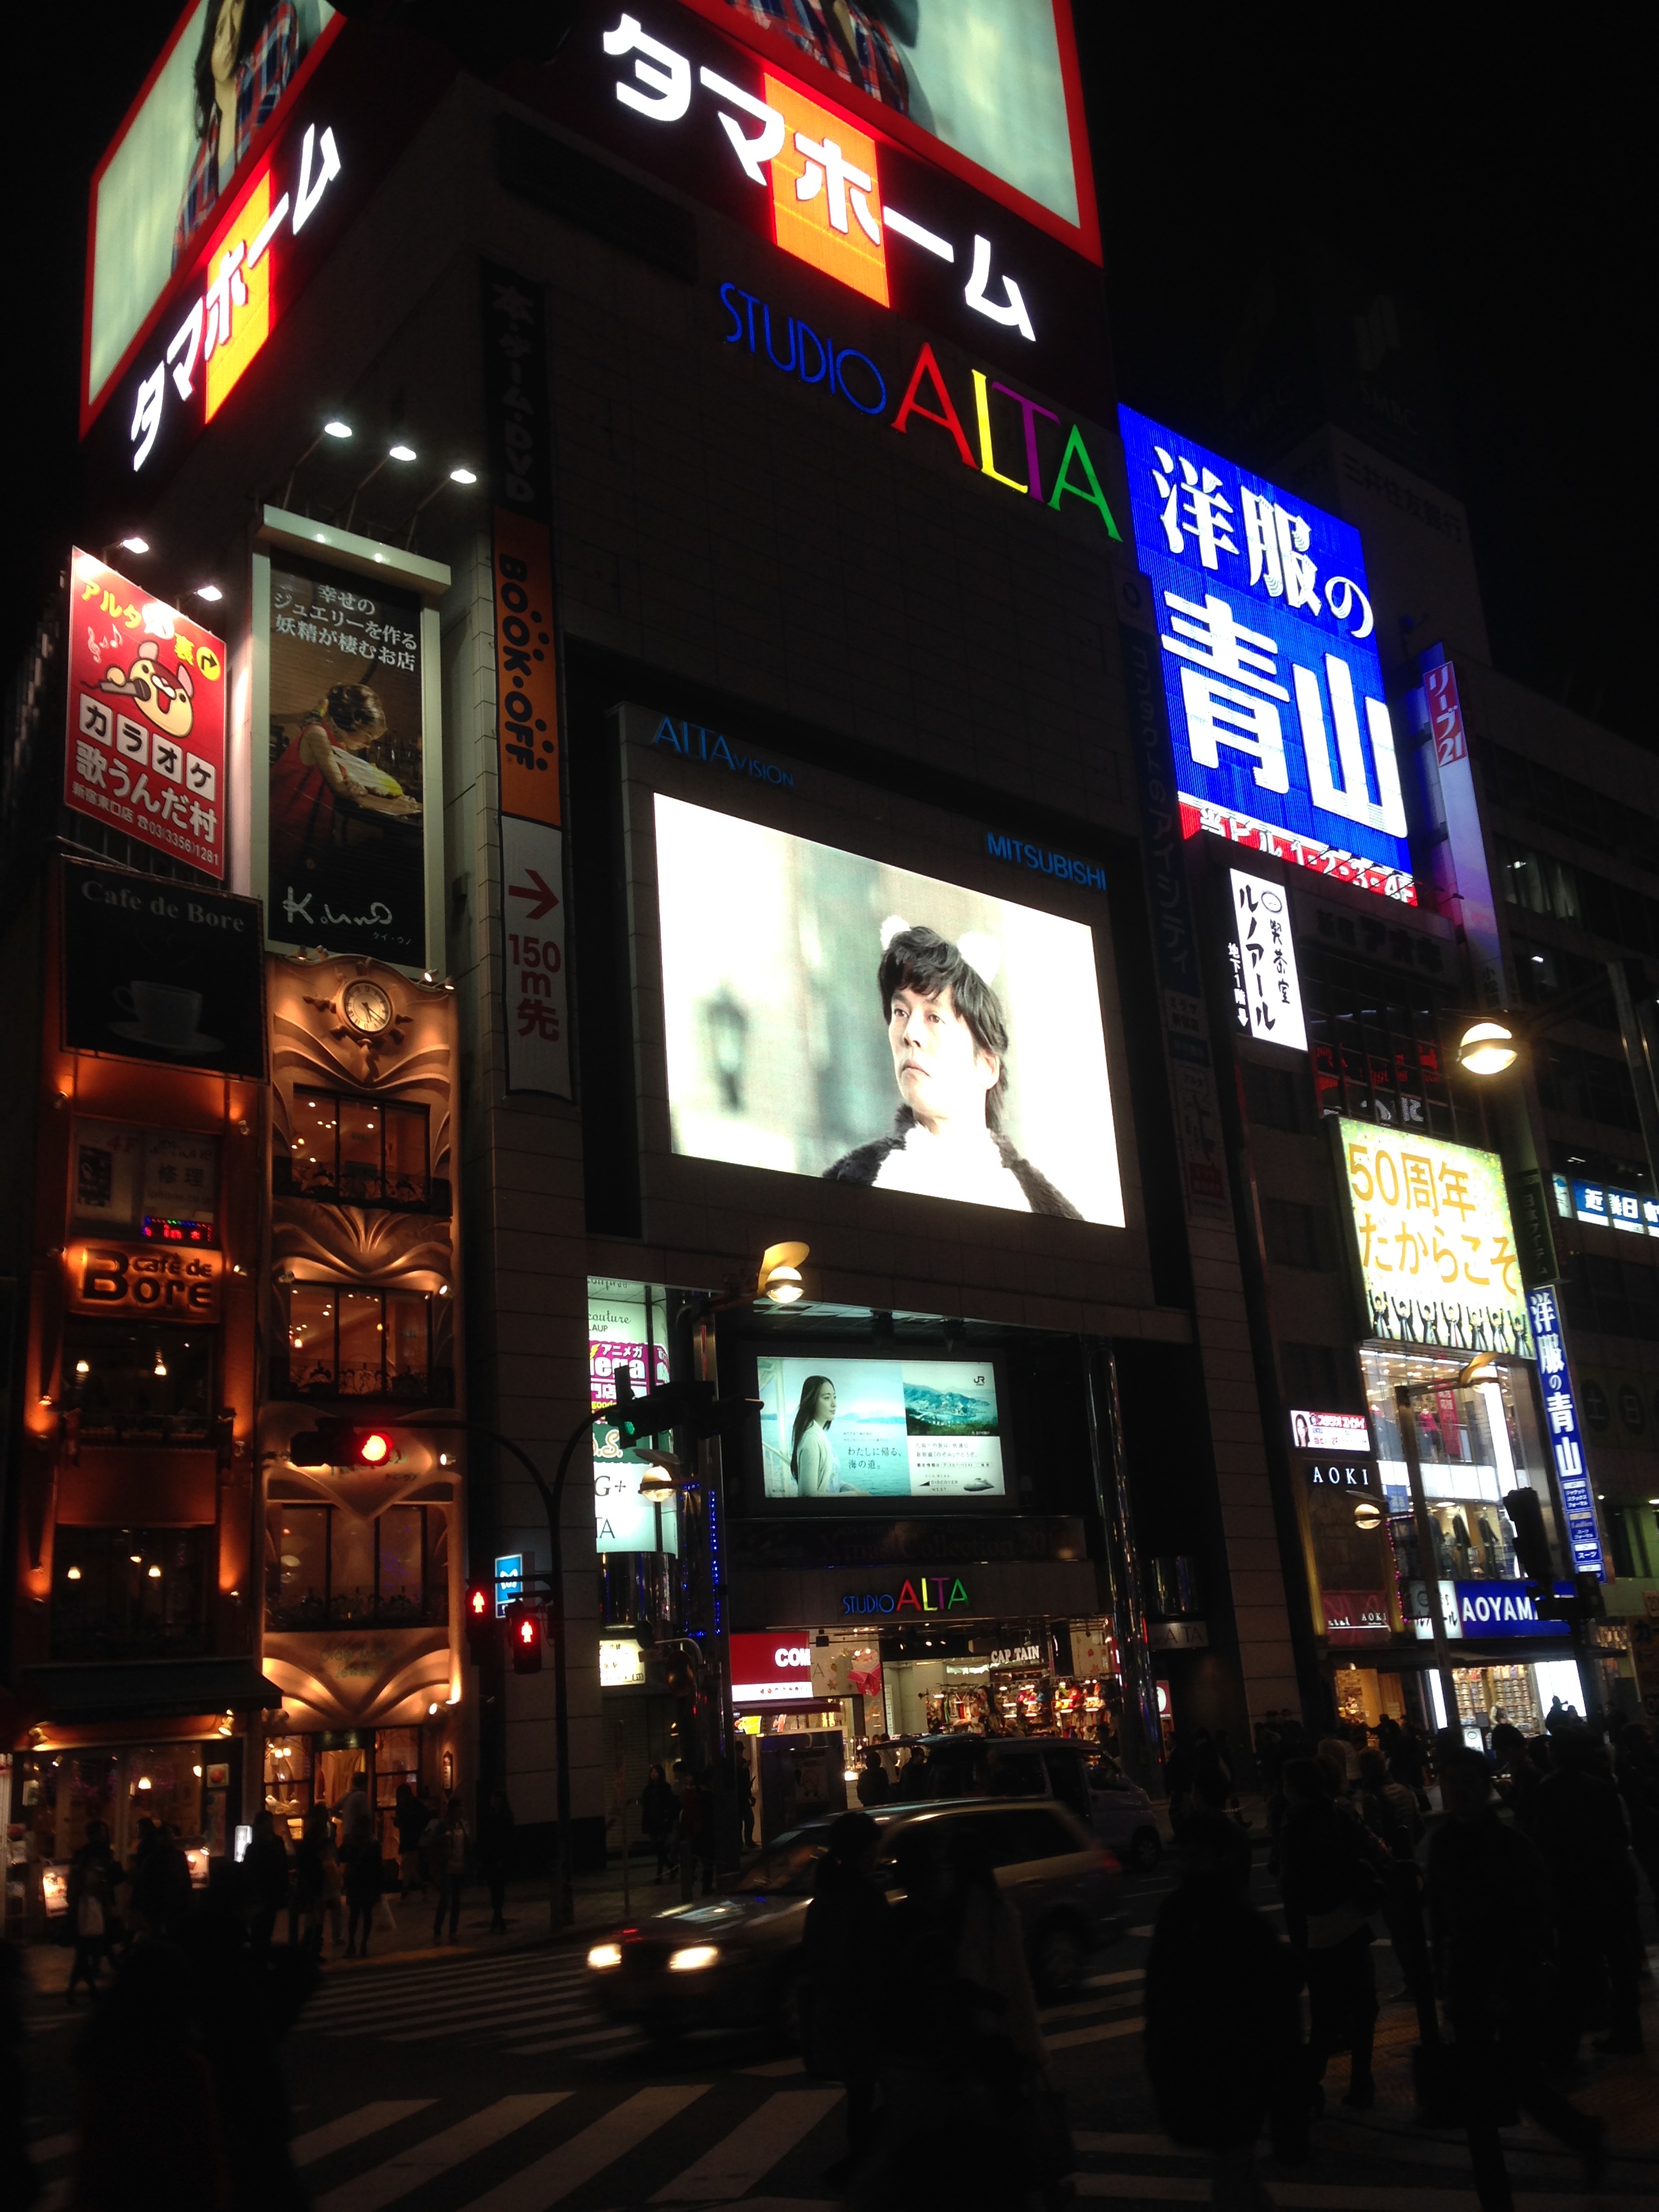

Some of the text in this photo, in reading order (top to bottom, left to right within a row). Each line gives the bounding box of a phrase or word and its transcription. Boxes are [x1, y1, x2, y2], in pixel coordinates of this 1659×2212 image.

[603, 13, 1036, 342] タマホーム
[130, 123, 341, 471] タマホーム
[719, 282, 1123, 542] STUDIO ALTA
[1151, 445, 1374, 639] 洋服の
[80, 579, 142, 630] アルタ
[274, 591, 417, 651] ジュエリーを作る
[318, 583, 375, 615] 幸せの
[275, 613, 416, 672] 妖精が棲むお店
[84, 703, 212, 781] カラオケ
[1162, 590, 1409, 840] 青山
[1427, 664, 1466, 766] リーブ21
[72, 781, 134, 825] 新宿東口店
[75, 739, 218, 845] 歌うんだ村
[987, 832, 1107, 891] MITSUBISHI
[81, 880, 245, 933] Cafe de Bore
[1239, 884, 1276, 1031] ルノアール
[1270, 918, 1290, 1004] 喫茶室
[157, 1164, 205, 1187] 修理
[1349, 1143, 1476, 1223] 50周年
[83, 1248, 212, 1308] Bore
[186, 1258, 213, 1277] de
[601, 1344, 643, 1359] アニメガ
[973, 1376, 985, 1384] JR
[1530, 1292, 1583, 1478] 洋服の青山
[848, 1446, 901, 1456] わたしに帰る、
[848, 1459, 880, 1469] 海の道。
[1313, 1466, 1369, 1485] AOKI
[1578, 1551, 1597, 1559] スーツ
[842, 1576, 970, 1614] STUDIO ALTA
[1361, 1612, 1387, 1621] AOKI
[1462, 1596, 1539, 1622] AOYAM
